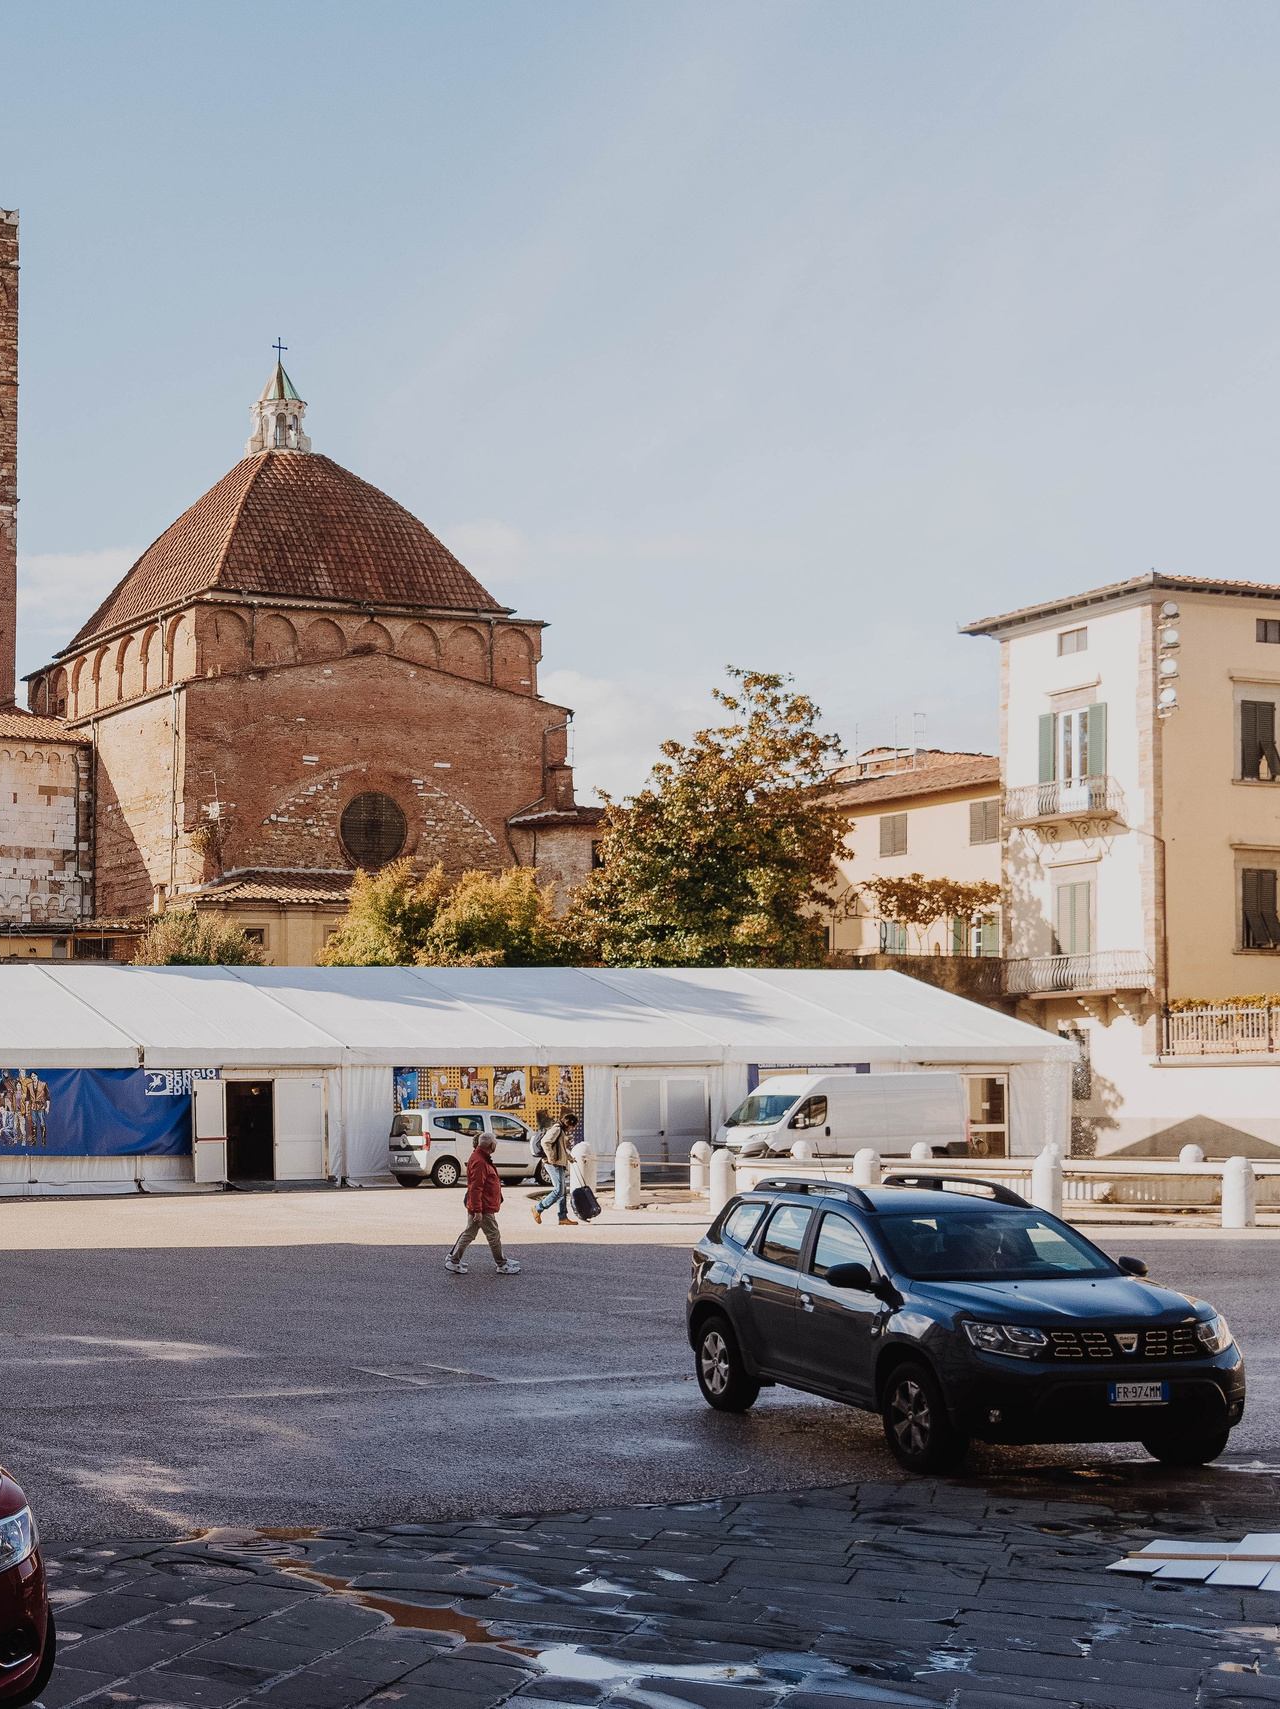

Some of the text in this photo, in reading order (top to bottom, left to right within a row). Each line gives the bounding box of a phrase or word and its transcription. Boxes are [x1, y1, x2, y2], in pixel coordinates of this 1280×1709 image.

[165, 1068, 216, 1079] SERGIO
[166, 1078, 192, 1089] BON
[167, 1086, 192, 1096] EDIT
